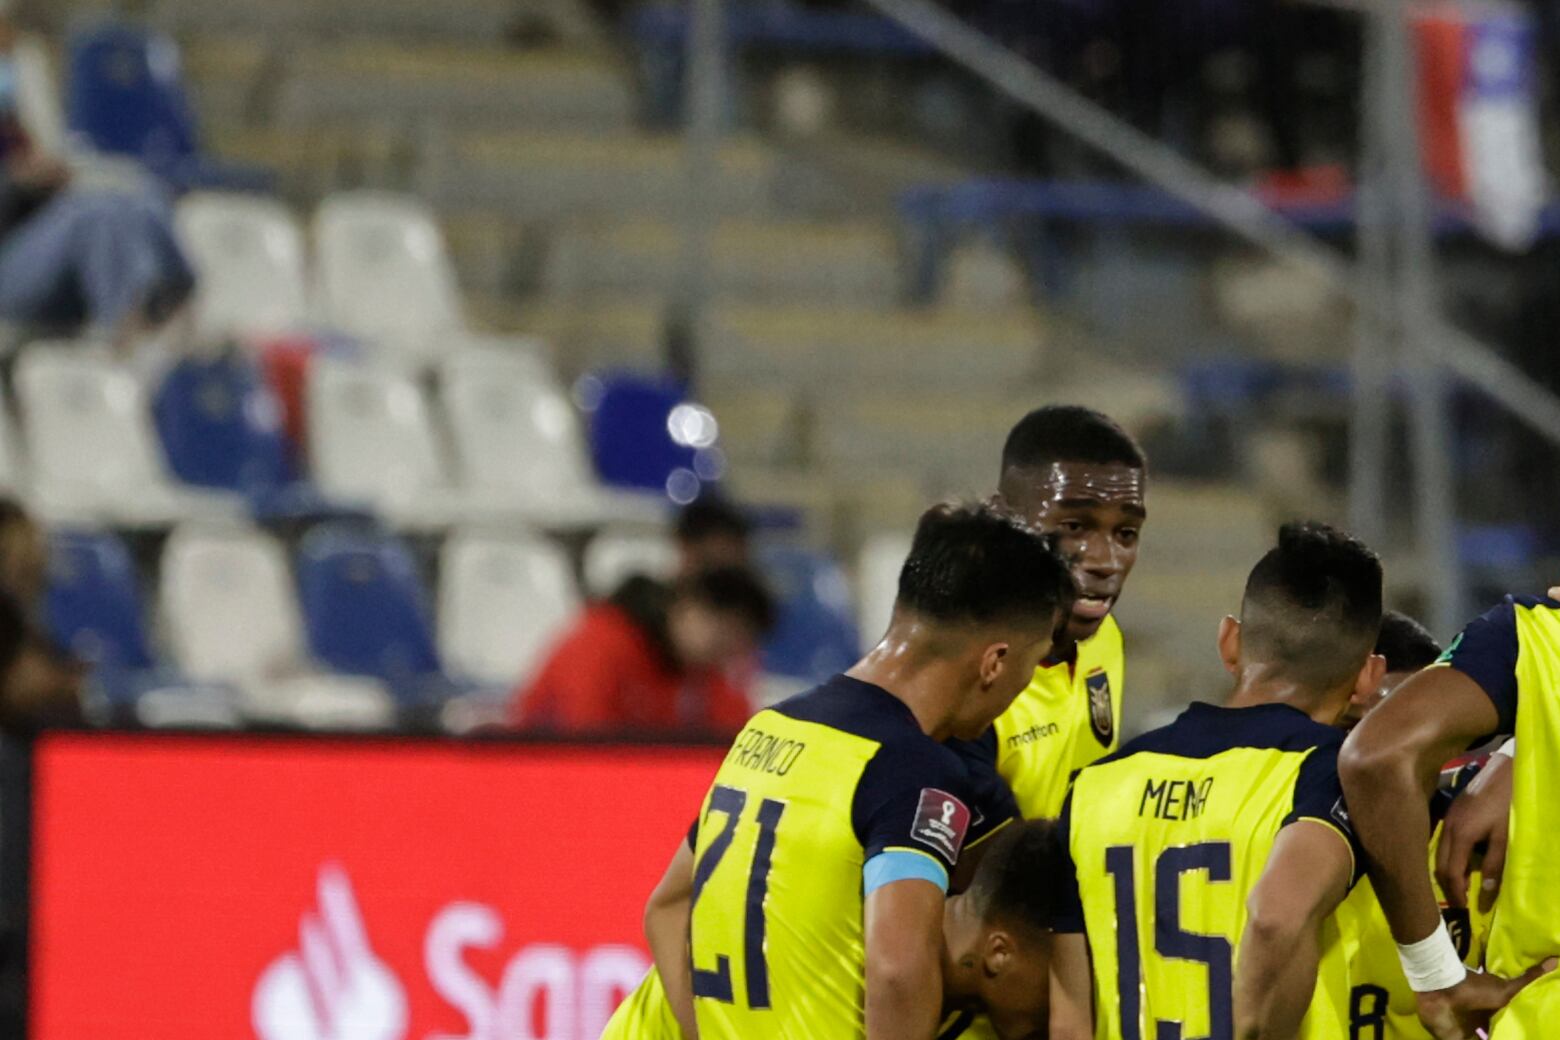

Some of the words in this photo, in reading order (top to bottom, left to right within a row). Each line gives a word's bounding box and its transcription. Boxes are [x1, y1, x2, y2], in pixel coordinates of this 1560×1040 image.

[728, 728, 806, 777] FRANCO
[1139, 776, 1214, 821] MENA
[693, 784, 786, 1011] 21
